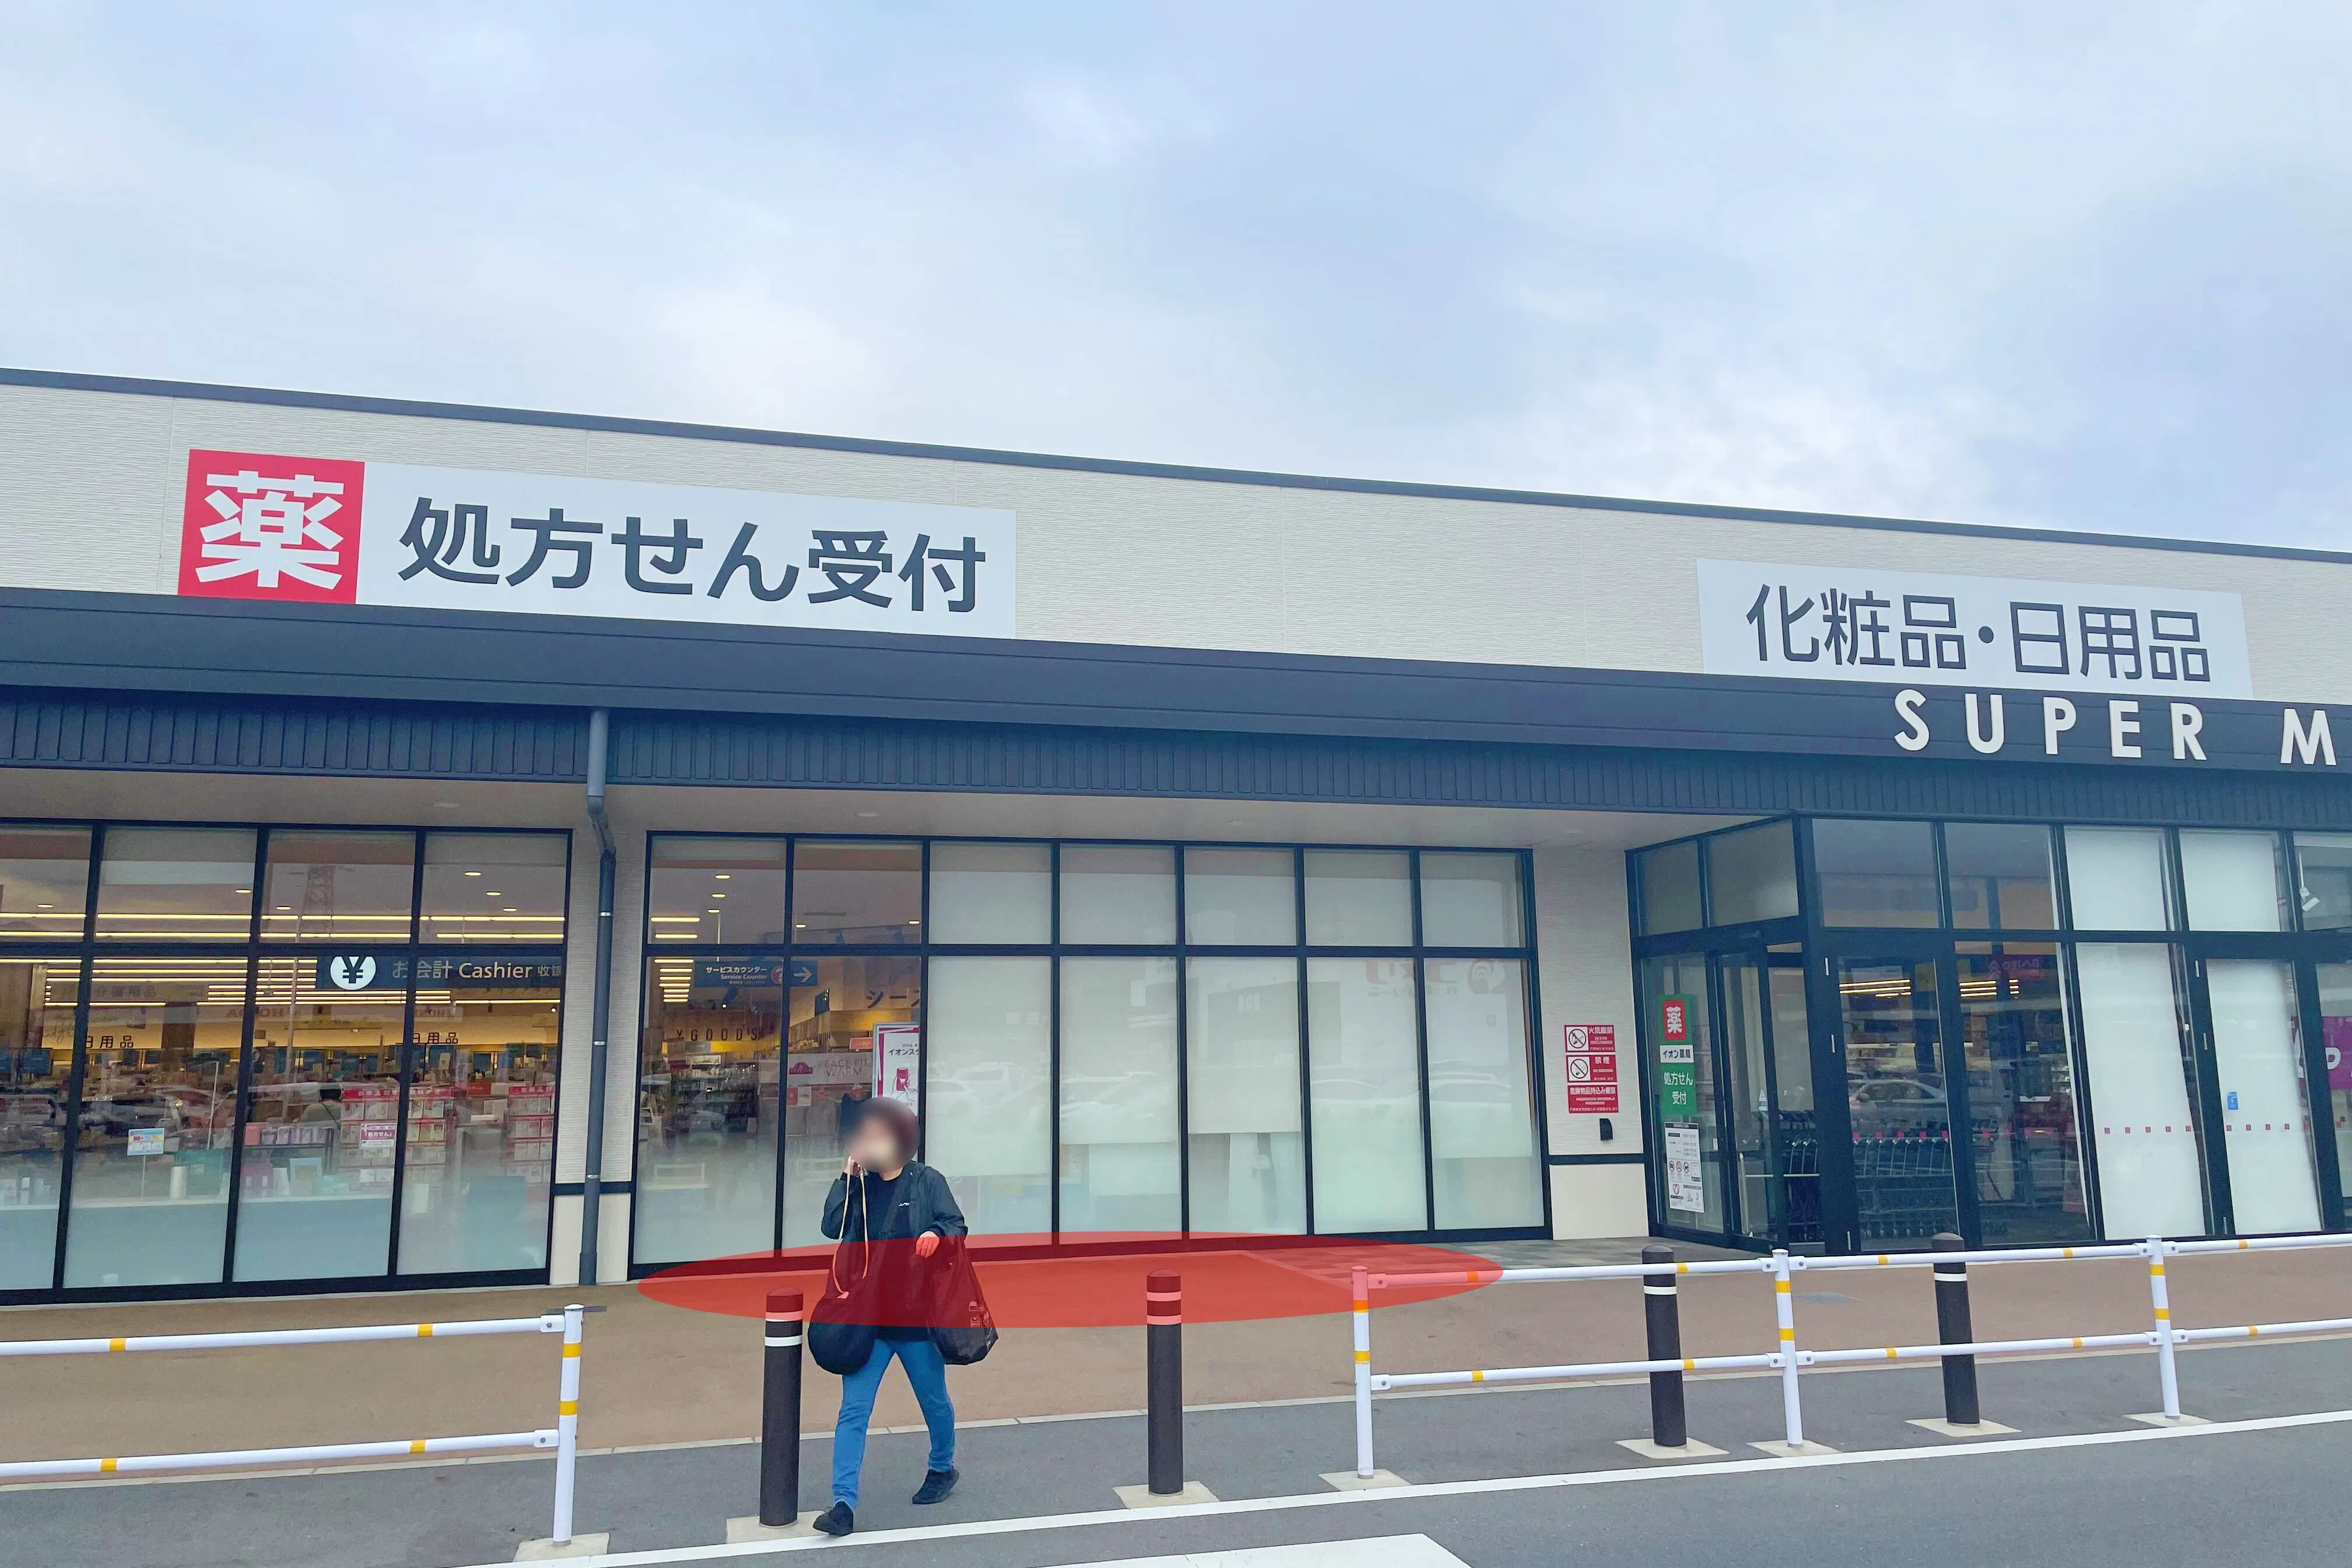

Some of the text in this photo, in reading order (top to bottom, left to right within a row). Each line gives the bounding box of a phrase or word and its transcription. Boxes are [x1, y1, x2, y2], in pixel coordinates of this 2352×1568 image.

[195, 470, 345, 589] 薬
[398, 496, 986, 613] 処方せん受付
[1746, 583, 2210, 682] 化粧品・日用品
[1894, 688, 2337, 766] SUPER M
[392, 960, 453, 979] お会計
[459, 962, 533, 978] Cashier
[1666, 1006, 1682, 1034] 薬
[86, 1035, 134, 1049] 日用品
[412, 1032, 459, 1044] 日用品
[1664, 1072, 1693, 1086] 処方せん
[1672, 1091, 1687, 1105] 受付
